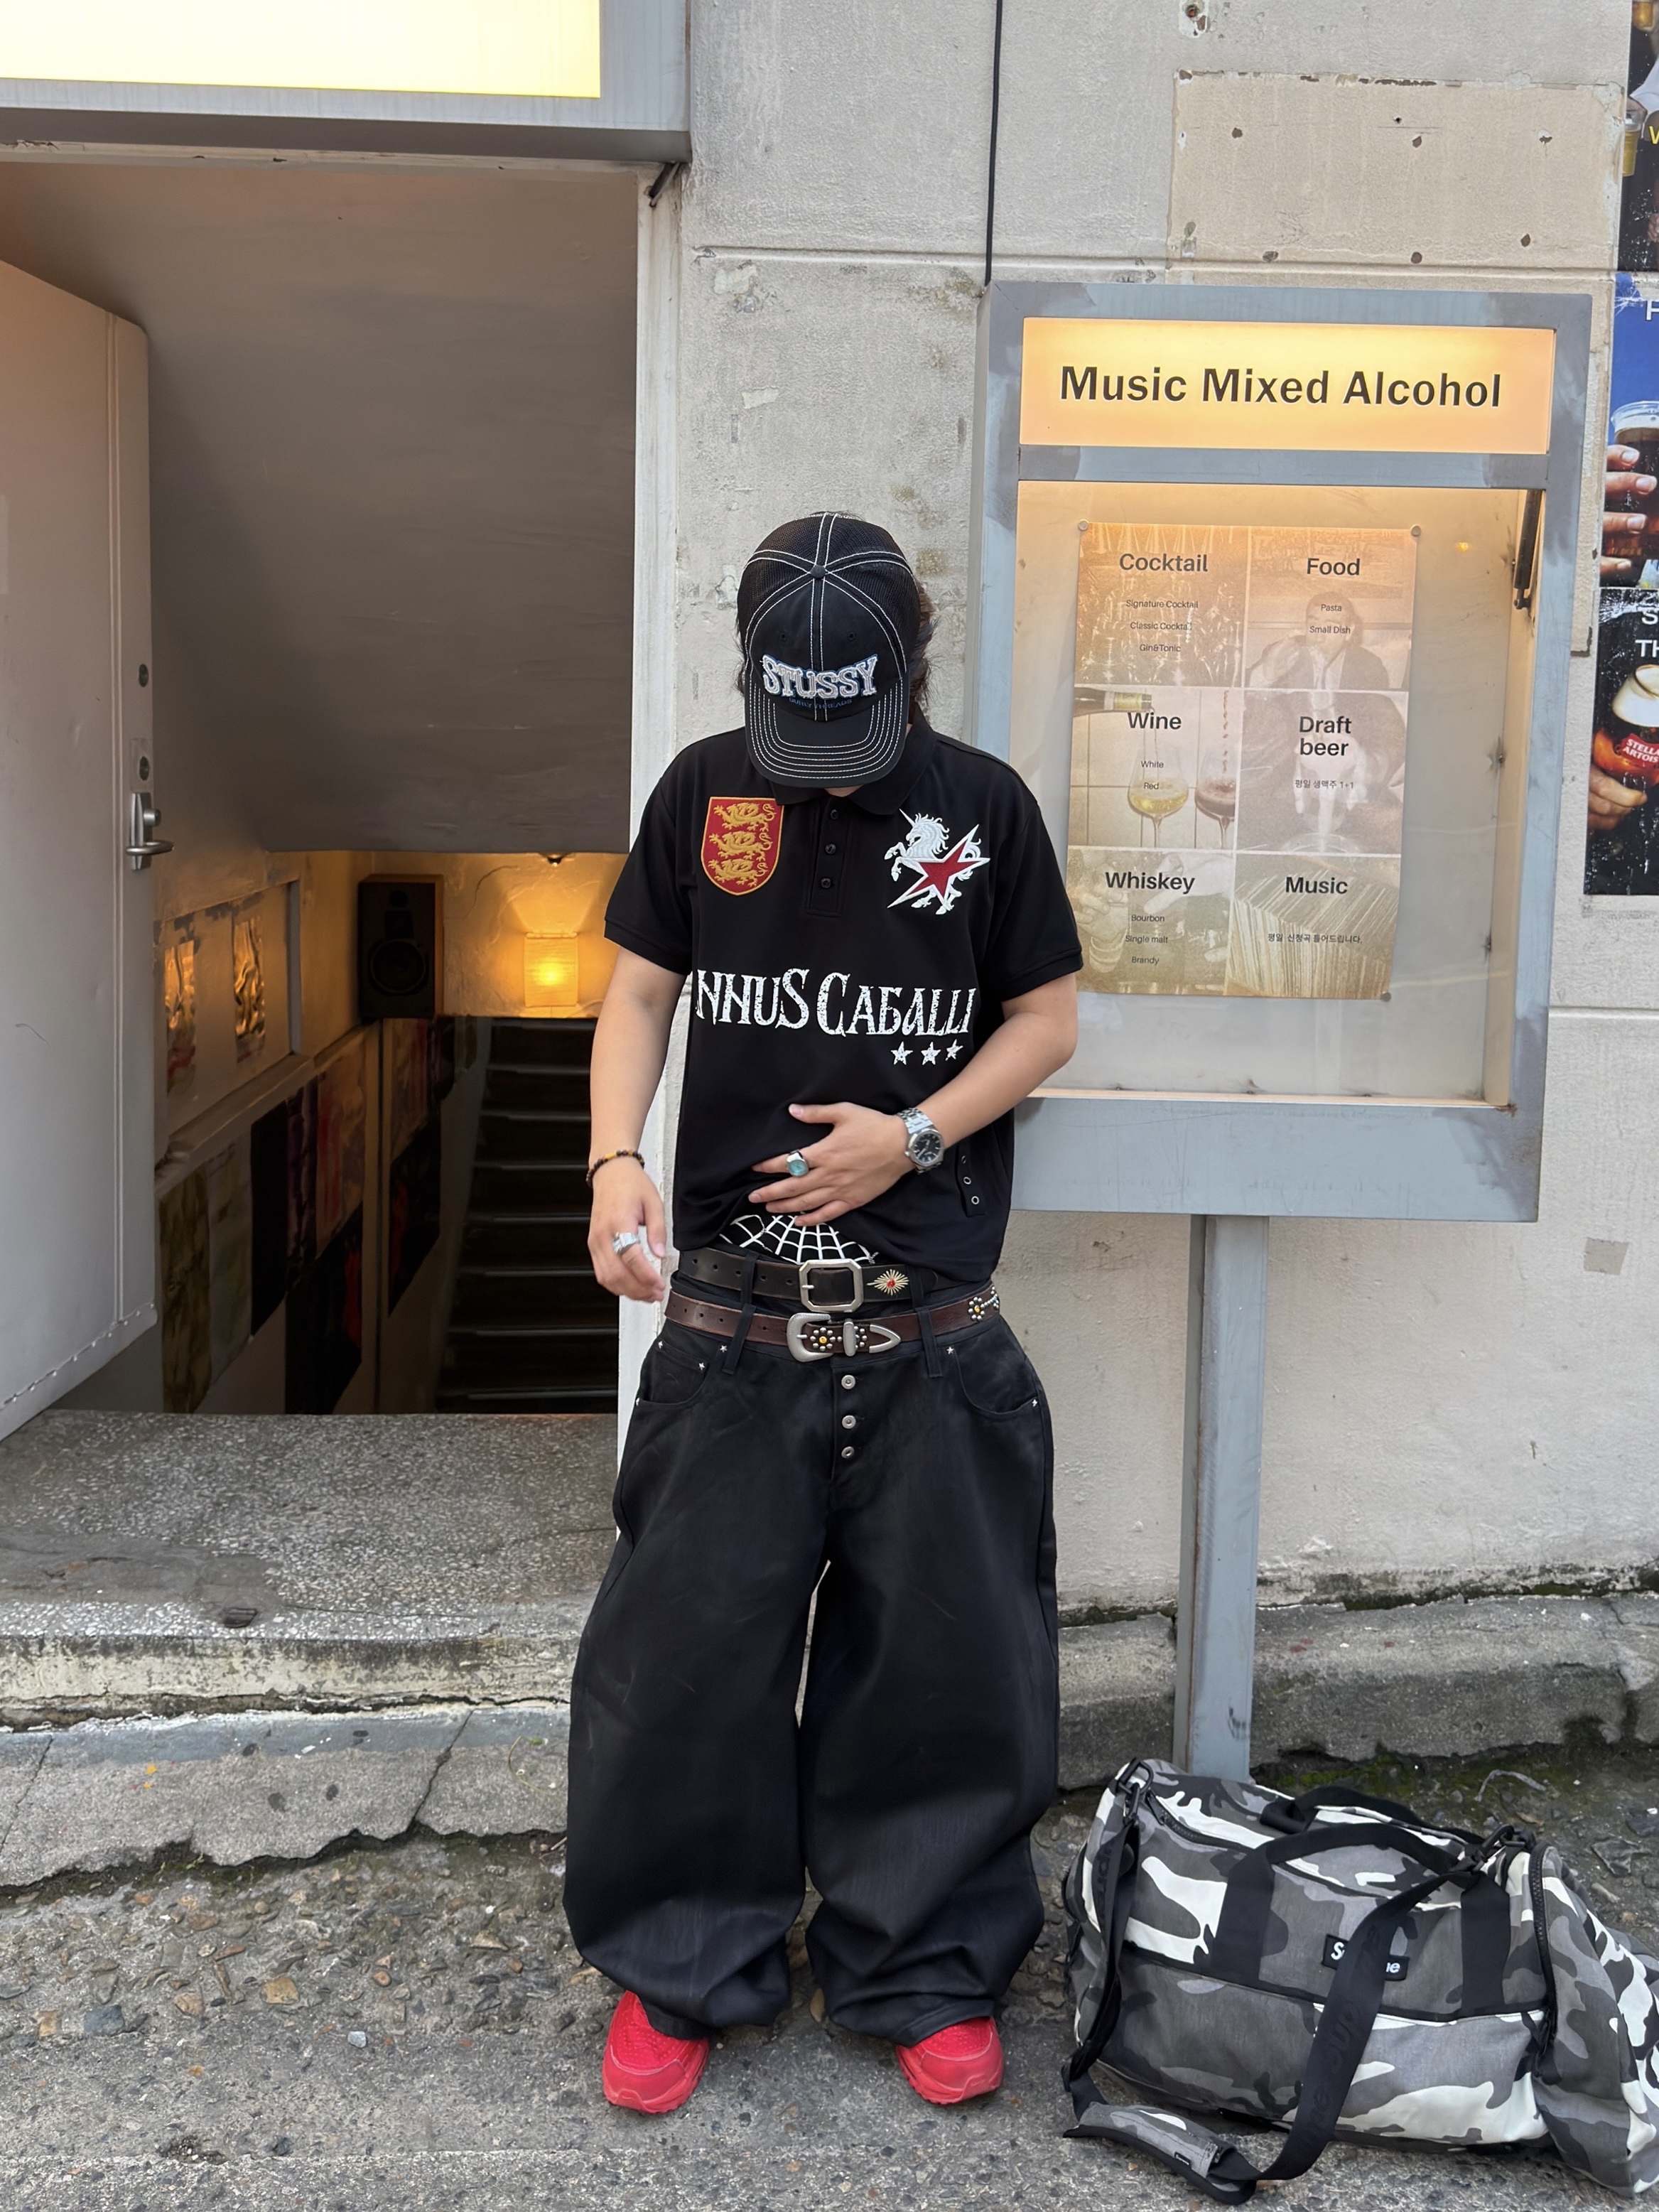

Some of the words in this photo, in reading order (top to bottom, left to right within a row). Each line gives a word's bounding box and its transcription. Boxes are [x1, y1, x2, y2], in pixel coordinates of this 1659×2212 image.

[1059, 366, 1187, 402] Music
[1202, 368, 1328, 404] Mixed
[1343, 371, 1501, 408] Alcohol
[1119, 553, 1208, 573] Cocktail
[1307, 558, 1360, 576] Food
[1125, 599, 1164, 609] Signature
[1166, 600, 1199, 609] Cocktail
[1321, 603, 1342, 612] Pasta
[1130, 621, 1158, 630] Classic
[1160, 622, 1192, 631] Cocktal
[1309, 625, 1331, 634] Small
[1333, 625, 1351, 634] Dish
[1139, 643, 1182, 652] Gin&Tonic
[760, 654, 878, 699] STUSSY
[1128, 712, 1182, 730] Wine
[1299, 716, 1351, 734] Draft
[1299, 738, 1349, 756] beer
[1622, 746, 1658, 763] ARTOIS
[1144, 782, 1160, 790] Red
[1313, 779, 1337, 789] 생맥주
[1105, 872, 1196, 895] Whiskey
[1285, 877, 1348, 895] Music
[1131, 914, 1165, 922] Bourbon
[1125, 935, 1150, 944] Single
[1131, 956, 1160, 966] Brandy
